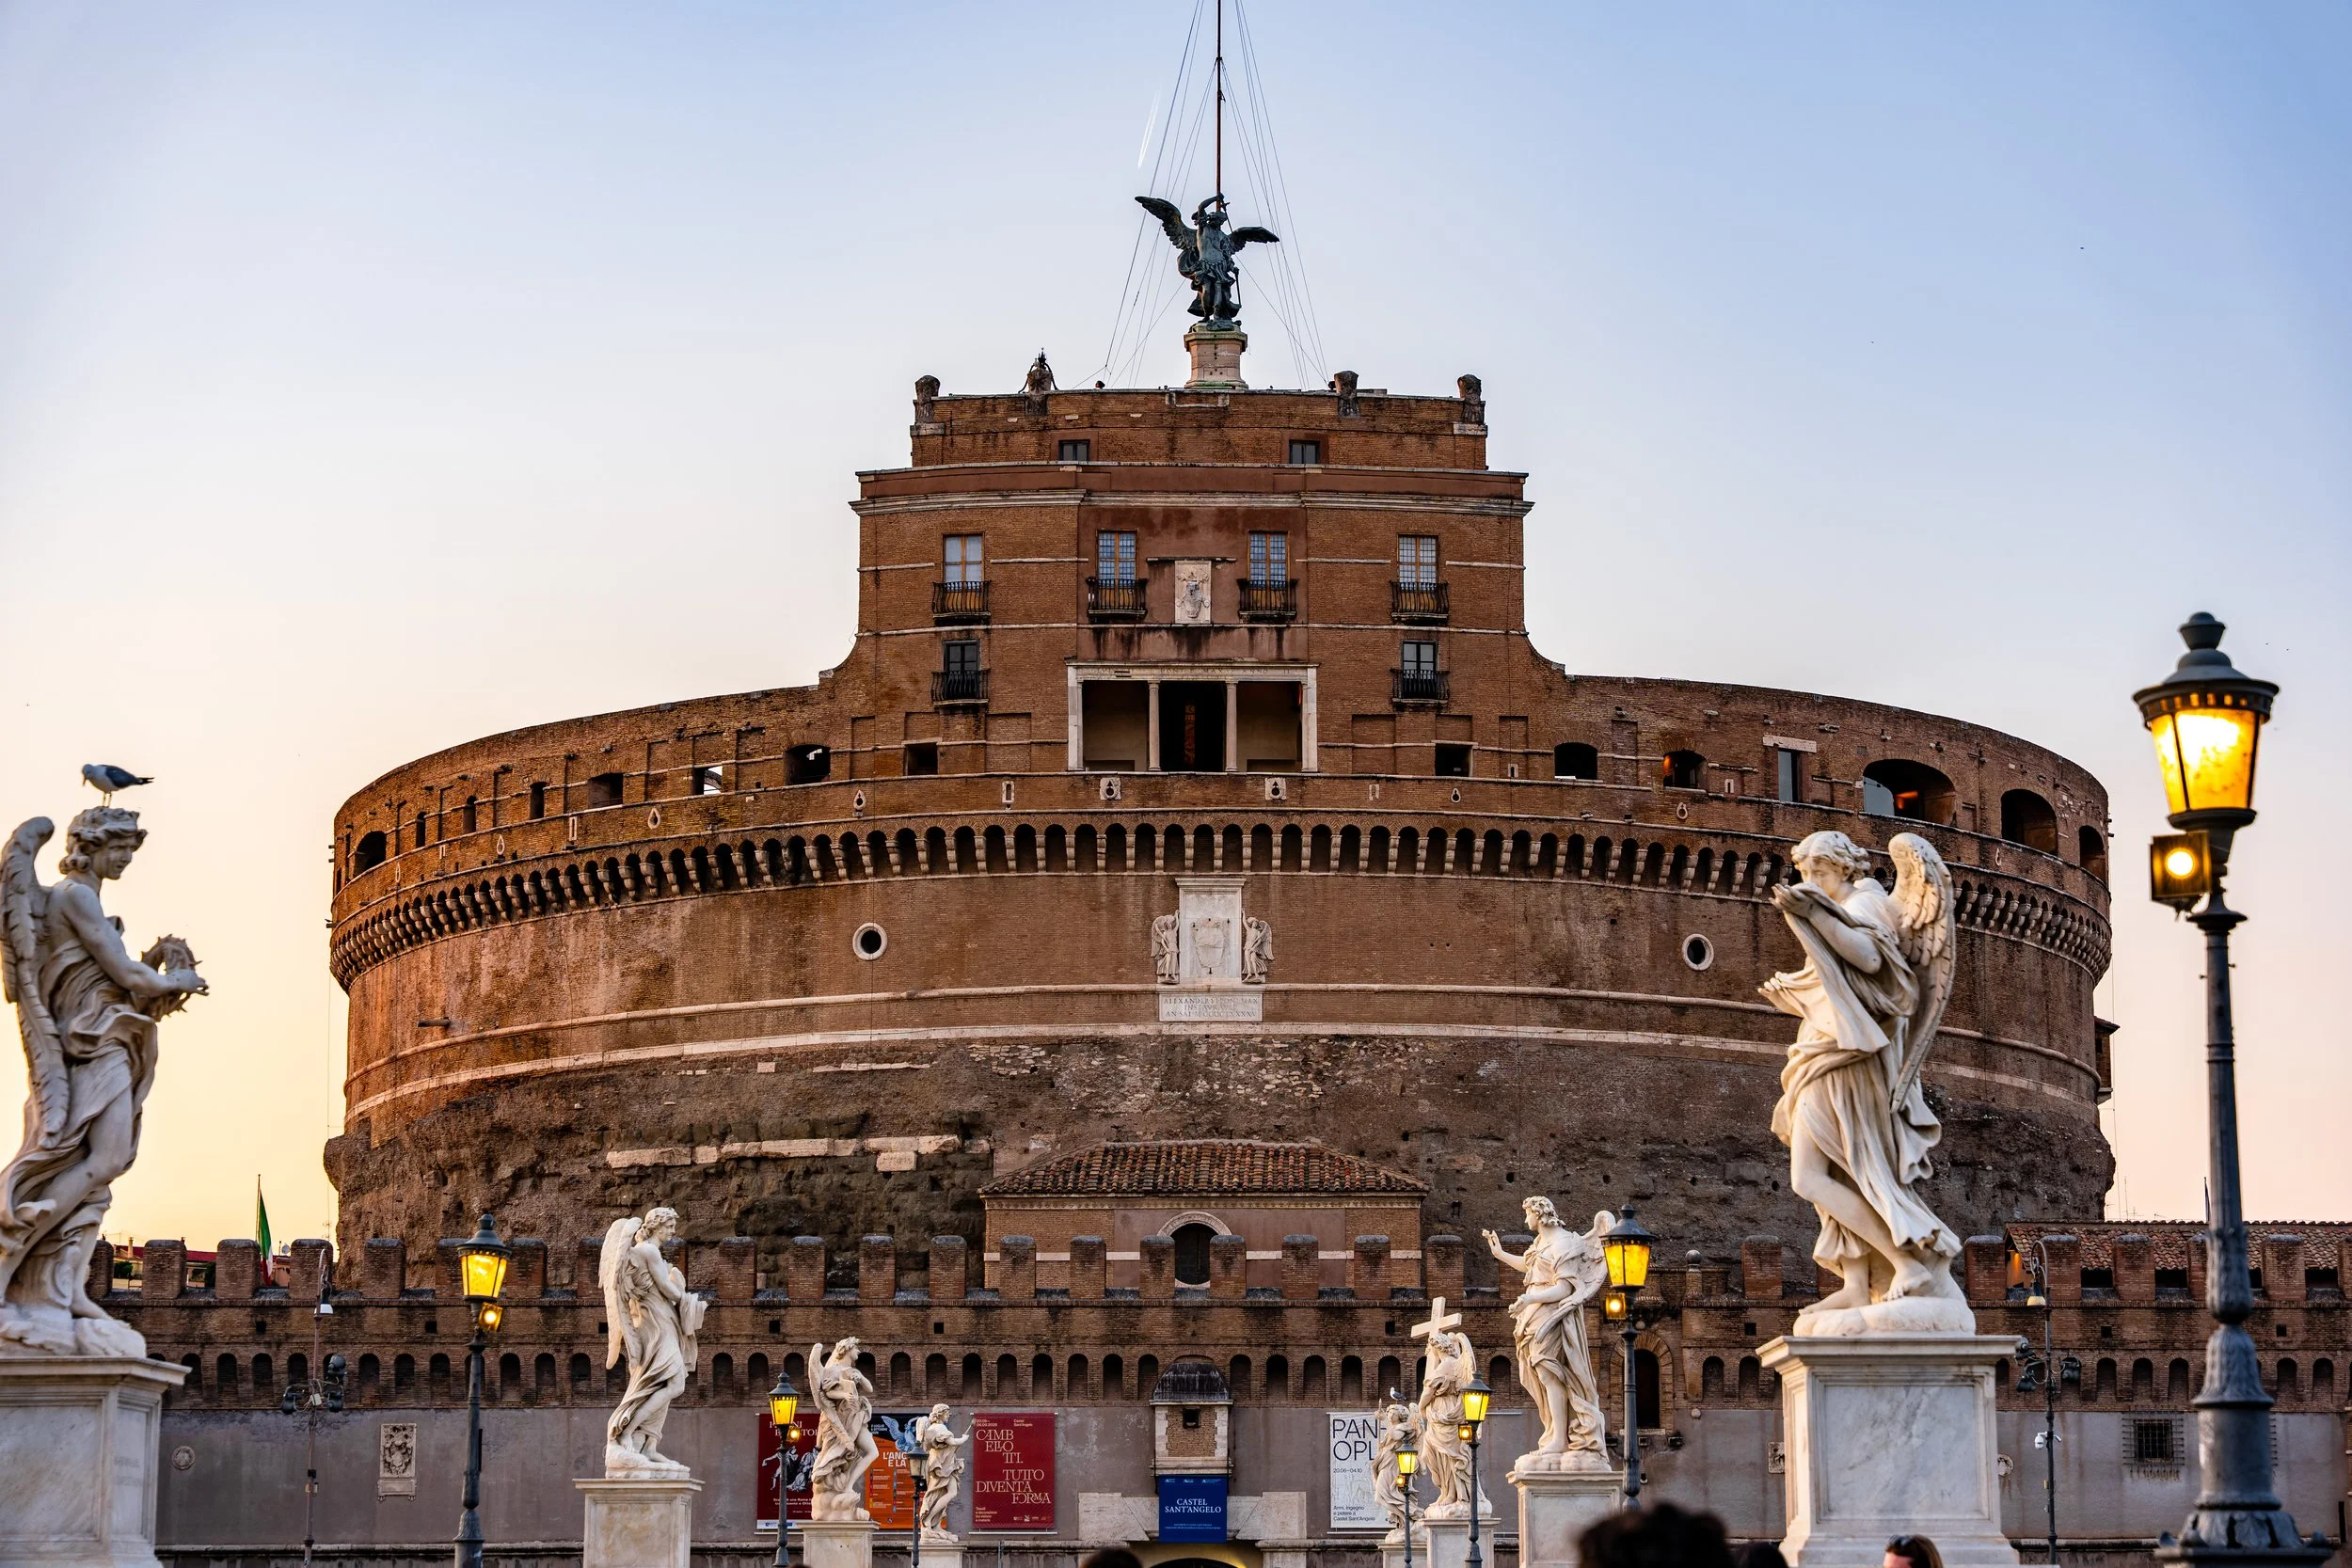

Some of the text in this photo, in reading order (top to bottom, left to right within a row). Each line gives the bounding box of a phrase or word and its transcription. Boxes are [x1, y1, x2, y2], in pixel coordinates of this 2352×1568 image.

[976, 1429, 1014, 1441] CAMB
[1333, 1440, 1375, 1461] OPL
[1002, 1468, 1045, 1481] TUTTO
[976, 1481, 1033, 1493] DIVENTA
[1011, 1492, 1052, 1504] FORMA
